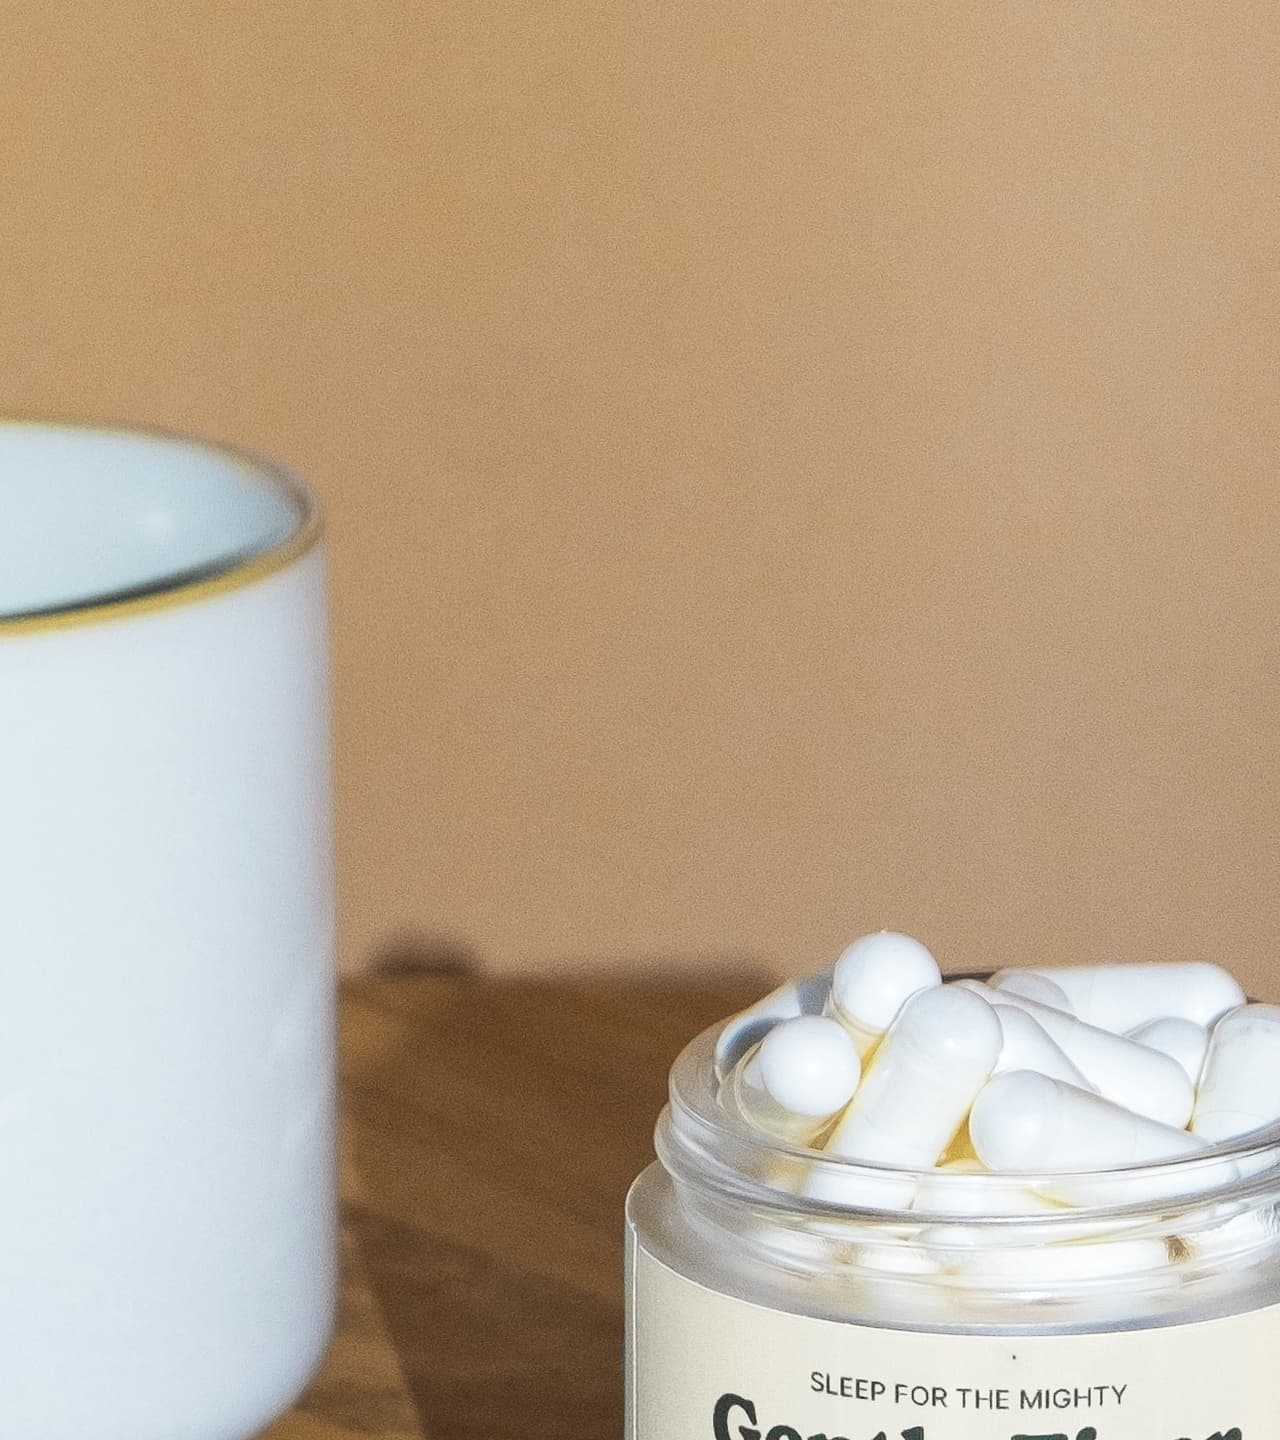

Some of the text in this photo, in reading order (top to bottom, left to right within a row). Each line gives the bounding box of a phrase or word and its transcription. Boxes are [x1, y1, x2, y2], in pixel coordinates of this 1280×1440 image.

[811, 1372, 1127, 1409] SLEEP FOR THE MIGHTY
